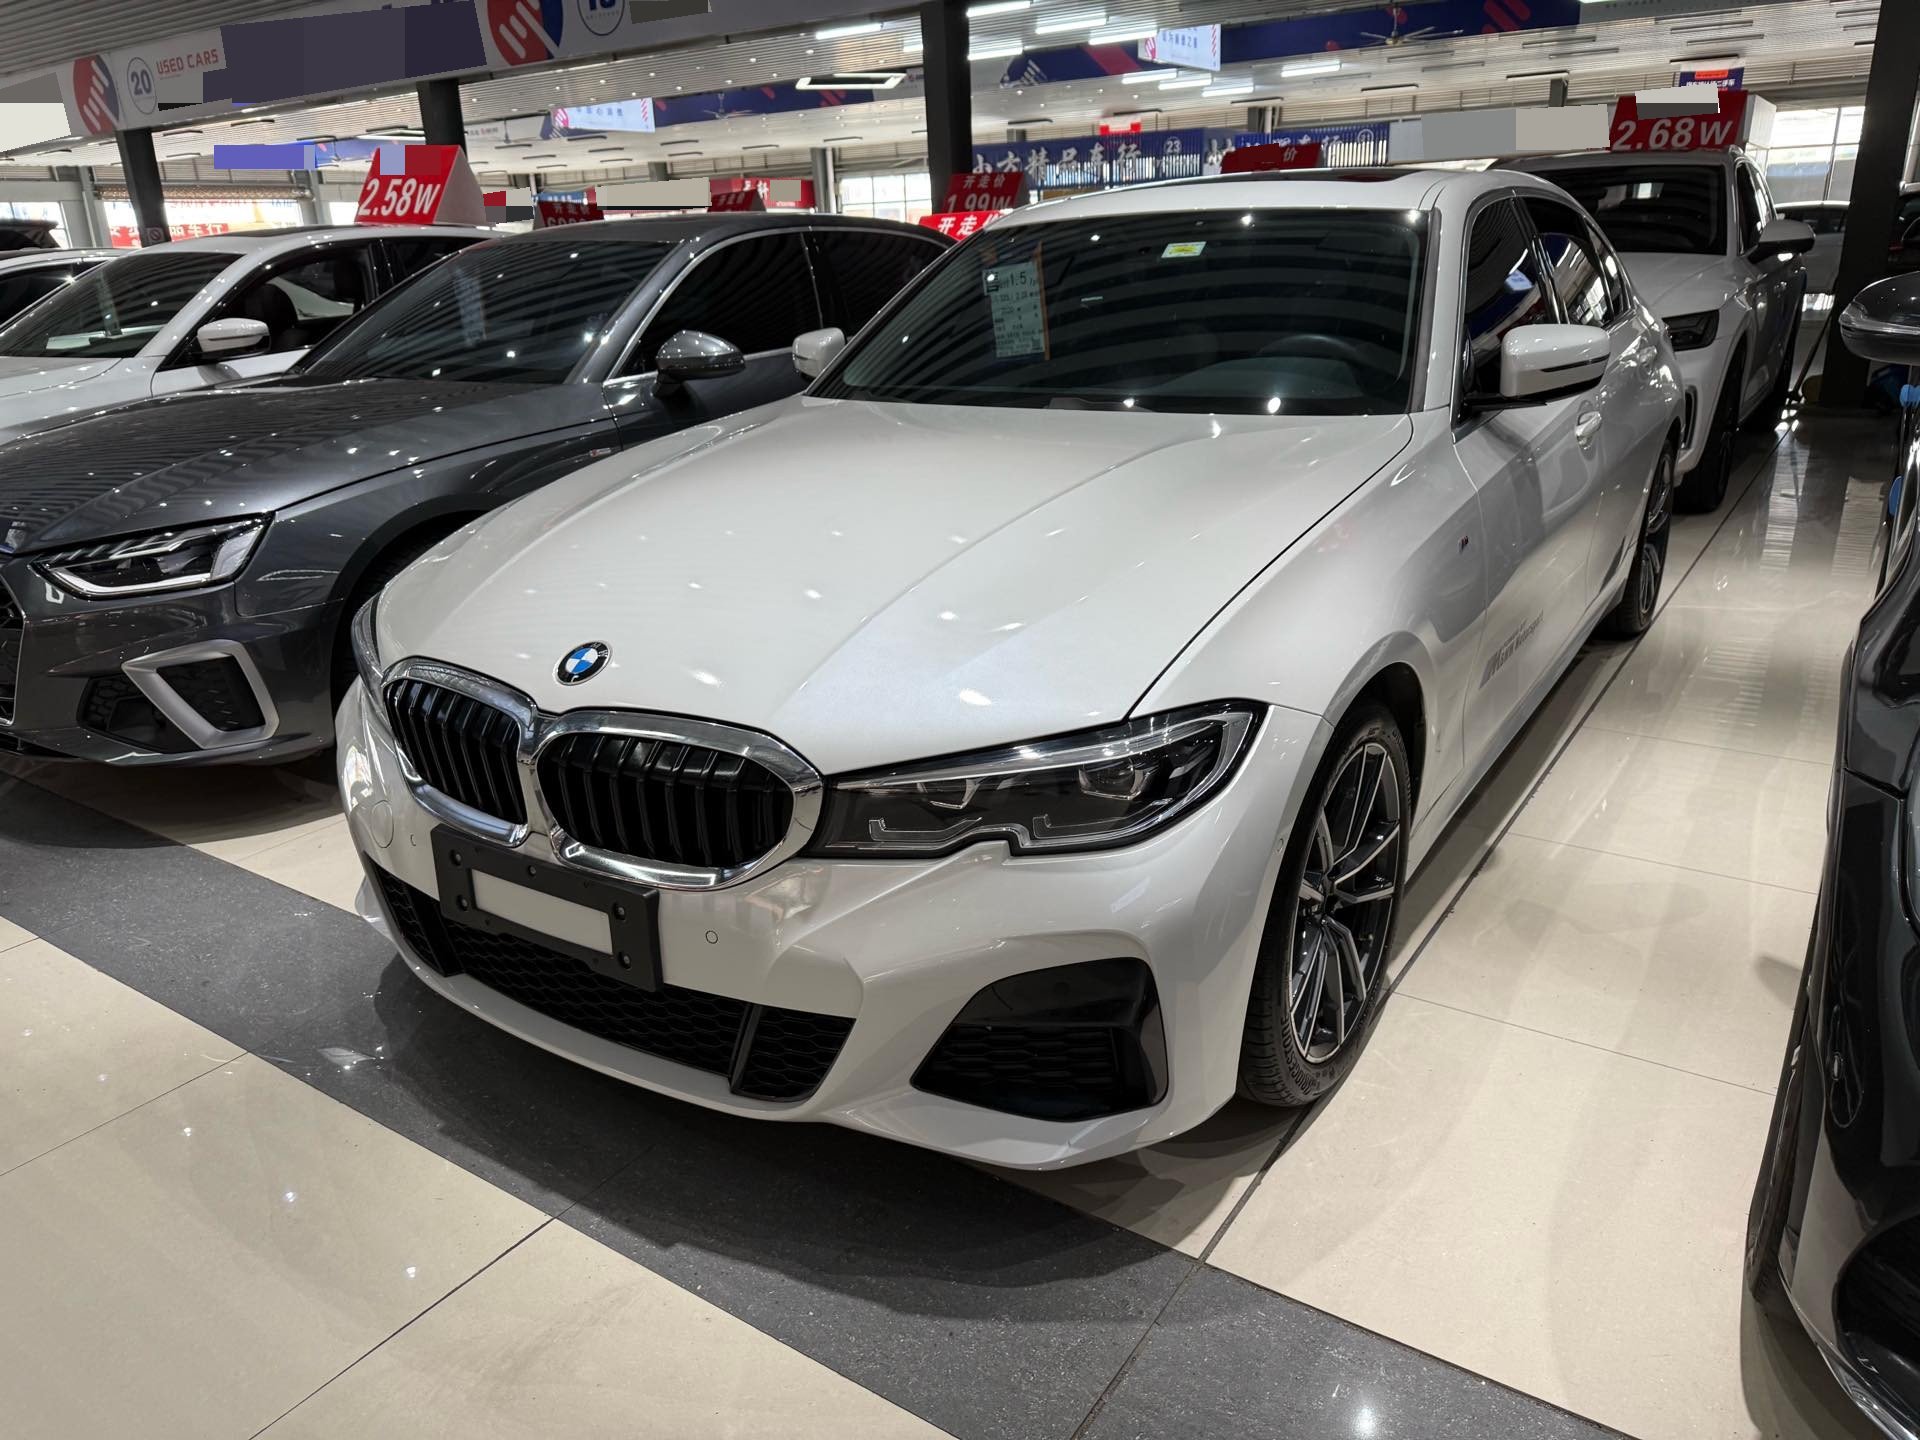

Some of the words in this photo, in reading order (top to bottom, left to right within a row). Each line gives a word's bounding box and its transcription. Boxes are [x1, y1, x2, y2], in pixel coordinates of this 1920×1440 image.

[156, 56, 184, 74] USED
[187, 49, 219, 69] CARS
[131, 69, 152, 96] 20
[1166, 140, 1181, 153] 23
[1613, 118, 1733, 150] 2.68W
[963, 174, 1006, 189] 开走价
[358, 178, 441, 216] 2.58W
[947, 193, 1012, 213] 199W
